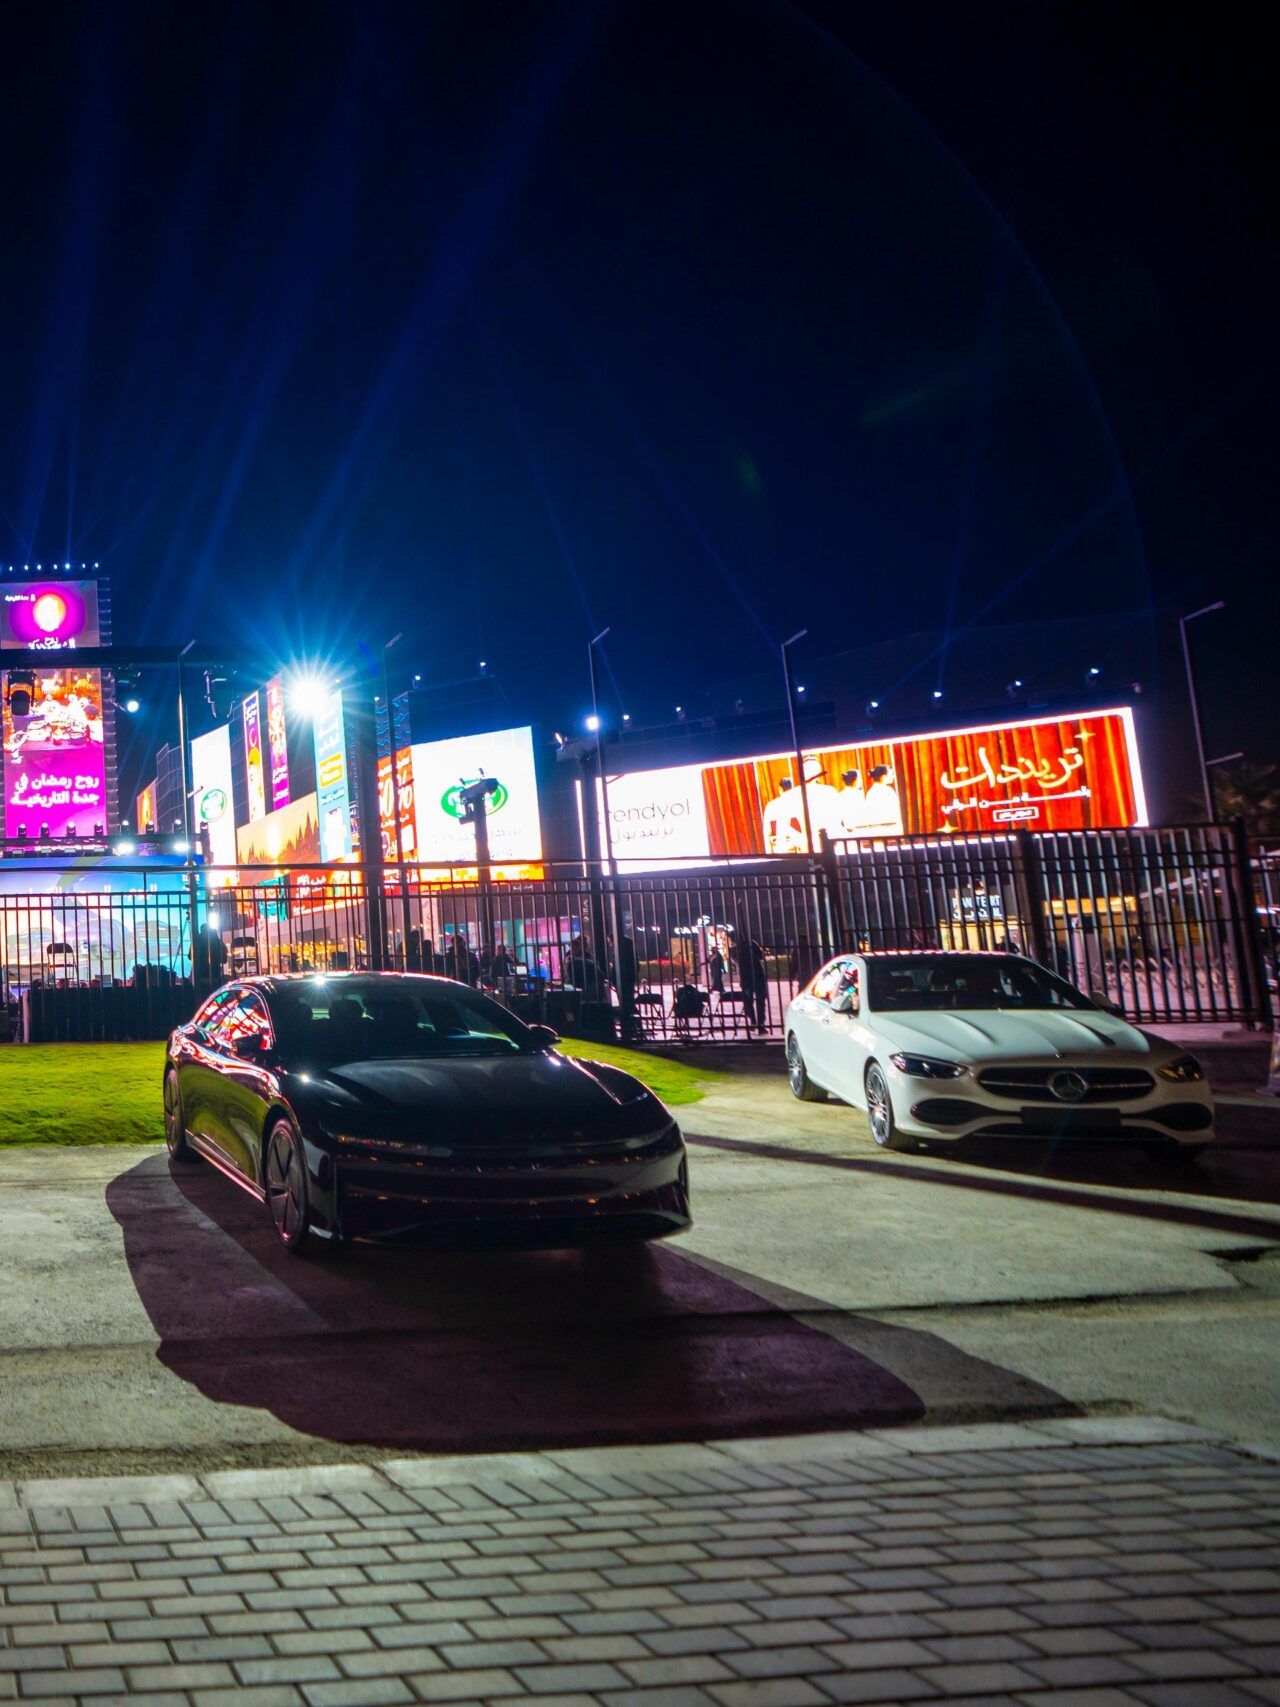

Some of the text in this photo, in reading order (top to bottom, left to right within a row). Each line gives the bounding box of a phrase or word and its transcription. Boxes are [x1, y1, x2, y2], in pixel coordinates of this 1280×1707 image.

[31, 773, 72, 789] رمضان
[75, 775, 100, 789] روح
[11, 790, 100, 808] جدة التاريخية
[607, 798, 690, 822] endyol
